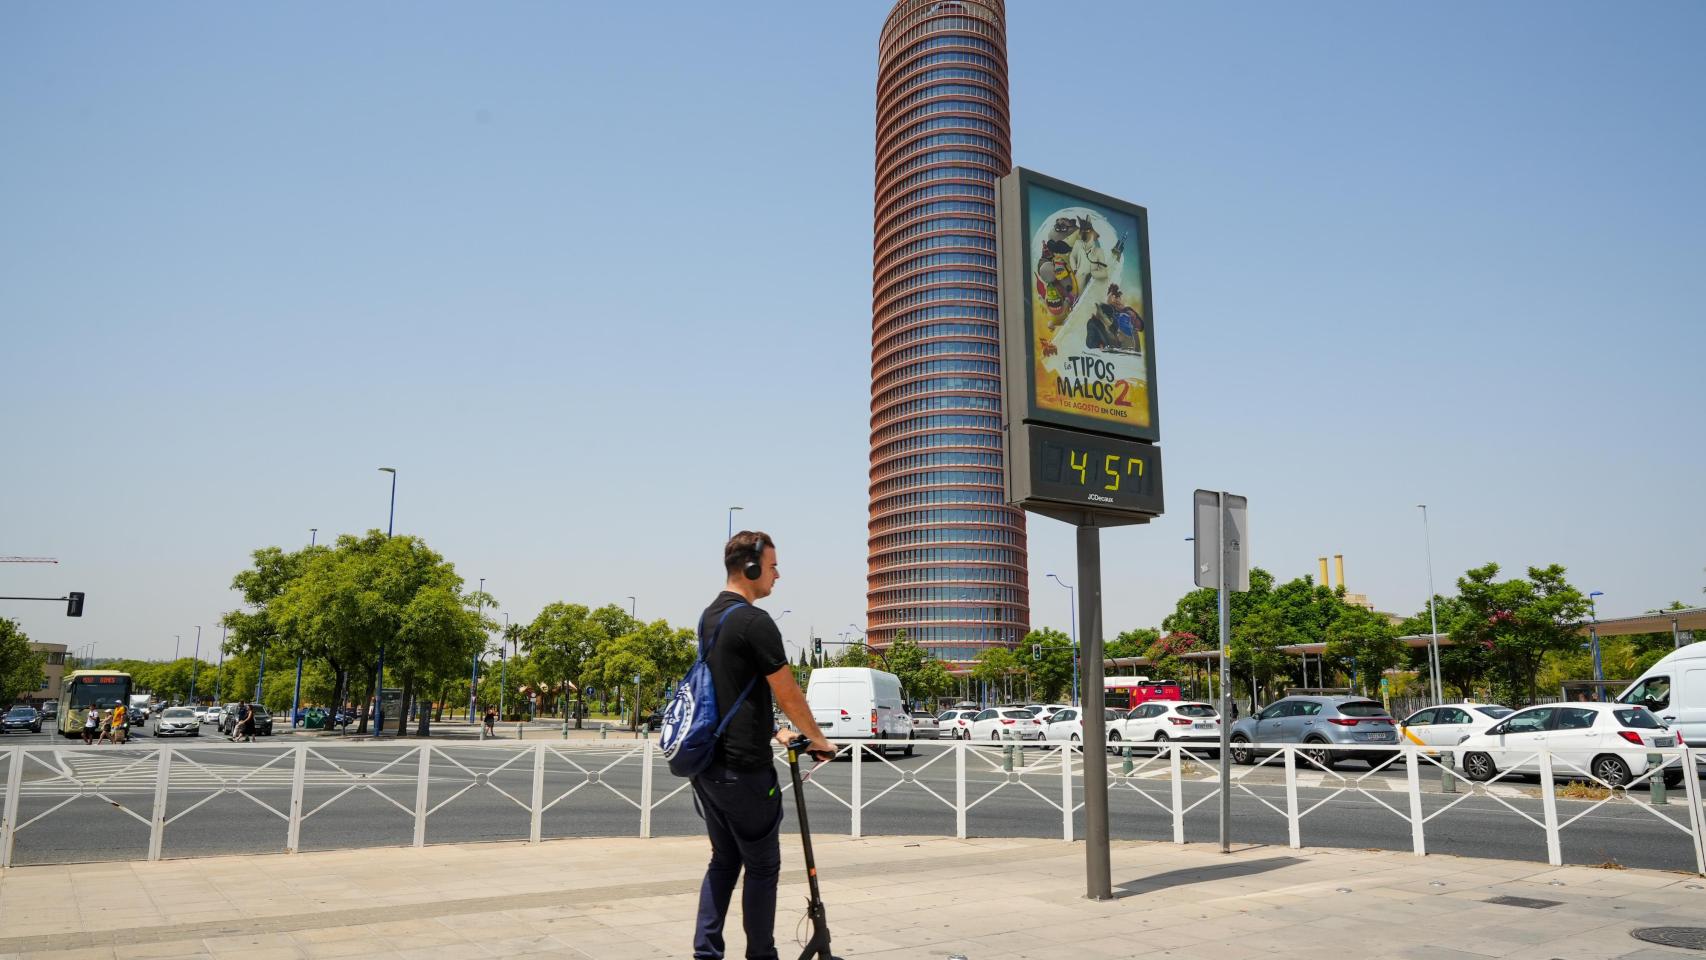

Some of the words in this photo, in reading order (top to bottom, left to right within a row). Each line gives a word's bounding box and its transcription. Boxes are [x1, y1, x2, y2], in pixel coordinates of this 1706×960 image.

[1068, 356, 1115, 383] TIPOS
[1057, 375, 1113, 405] MALOS
[1114, 379, 1133, 407] 2
[1073, 402, 1100, 413] AGOSTO
[1110, 408, 1128, 417] CINES
[1088, 494, 1114, 503] JCDecaux
